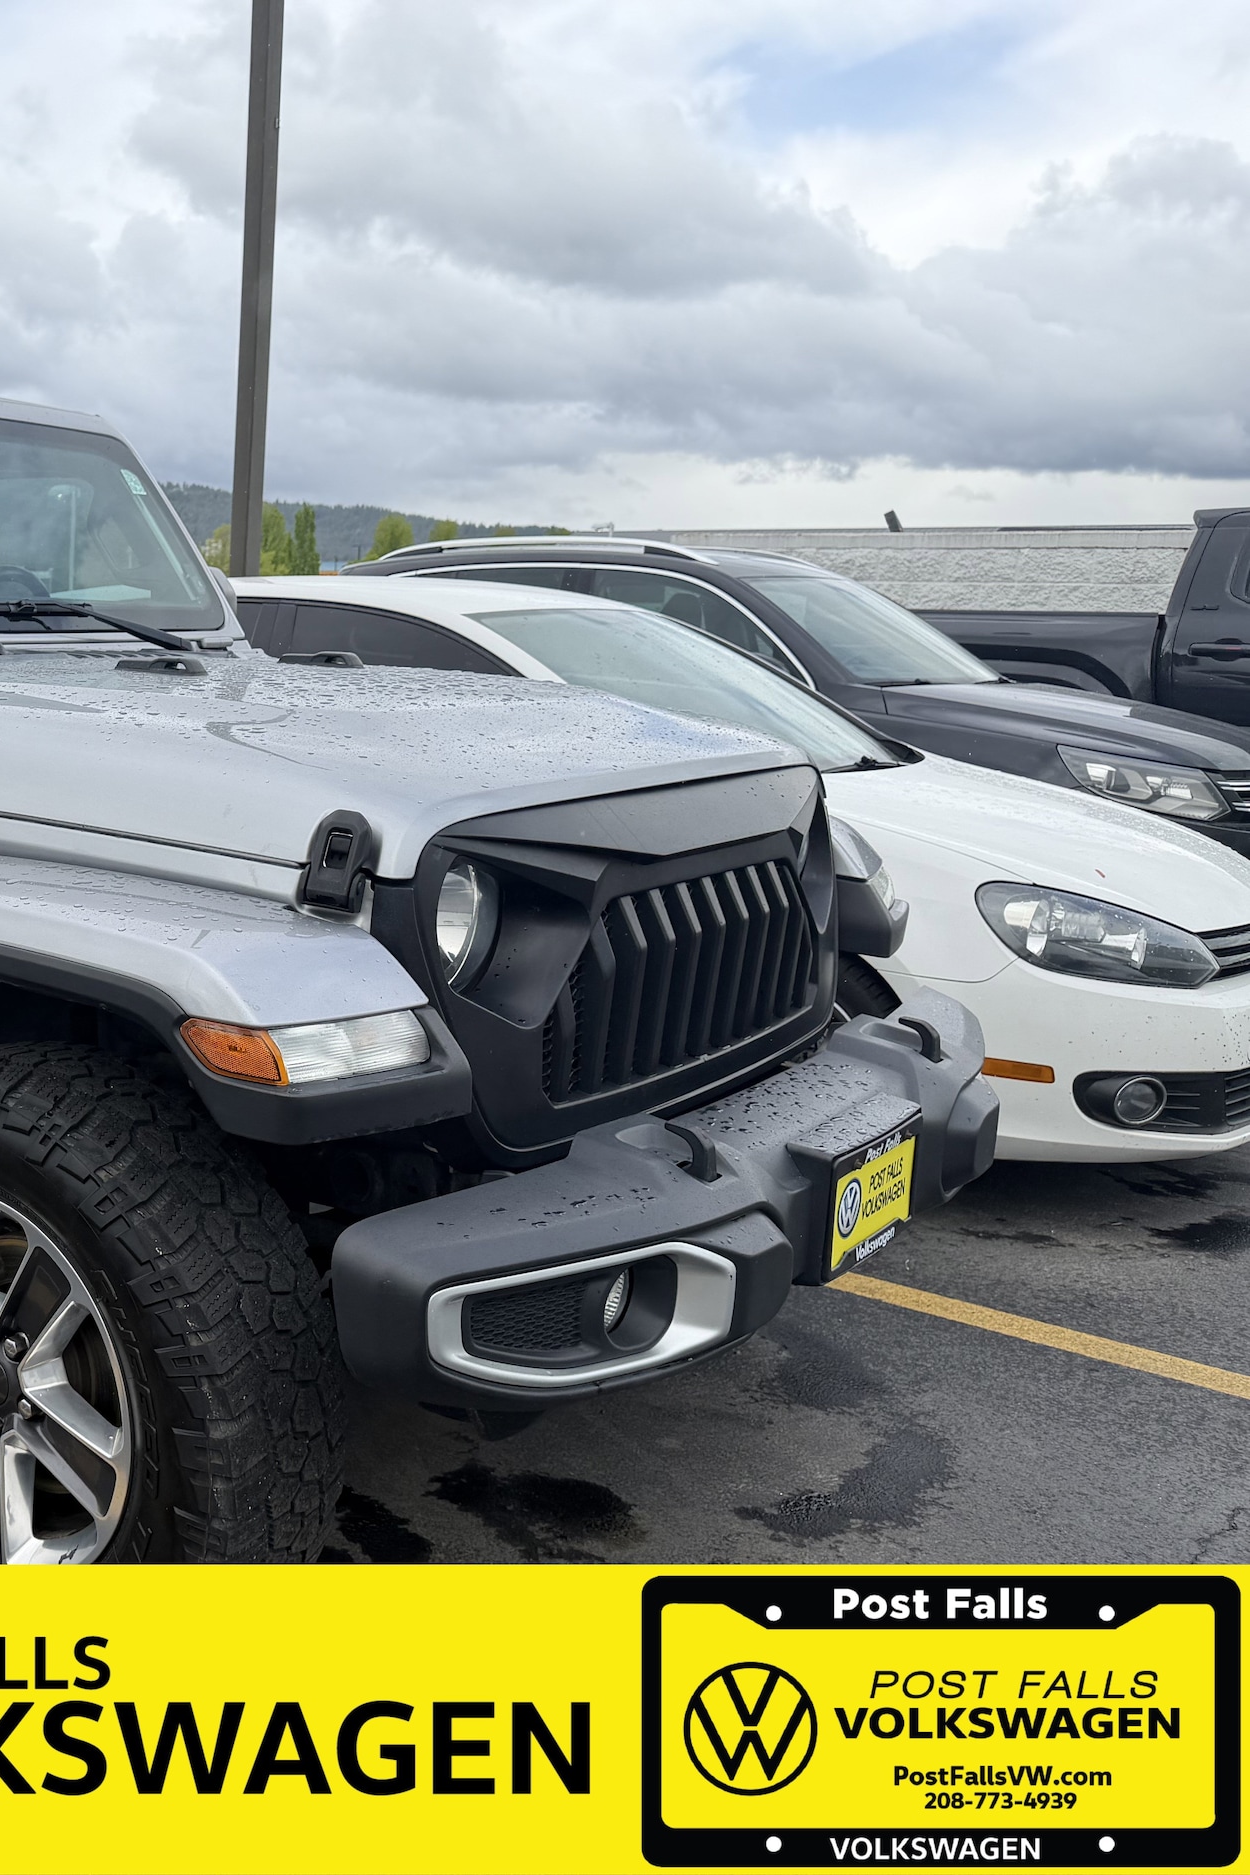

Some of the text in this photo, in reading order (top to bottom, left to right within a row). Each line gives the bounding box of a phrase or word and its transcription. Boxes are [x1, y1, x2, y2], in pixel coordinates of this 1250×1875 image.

[865, 1132, 901, 1164] Post Falls
[868, 1157, 903, 1193] POST FALLS
[861, 1178, 906, 1220] VOLKSWAGEN
[855, 1226, 895, 1261] Volkswagen
